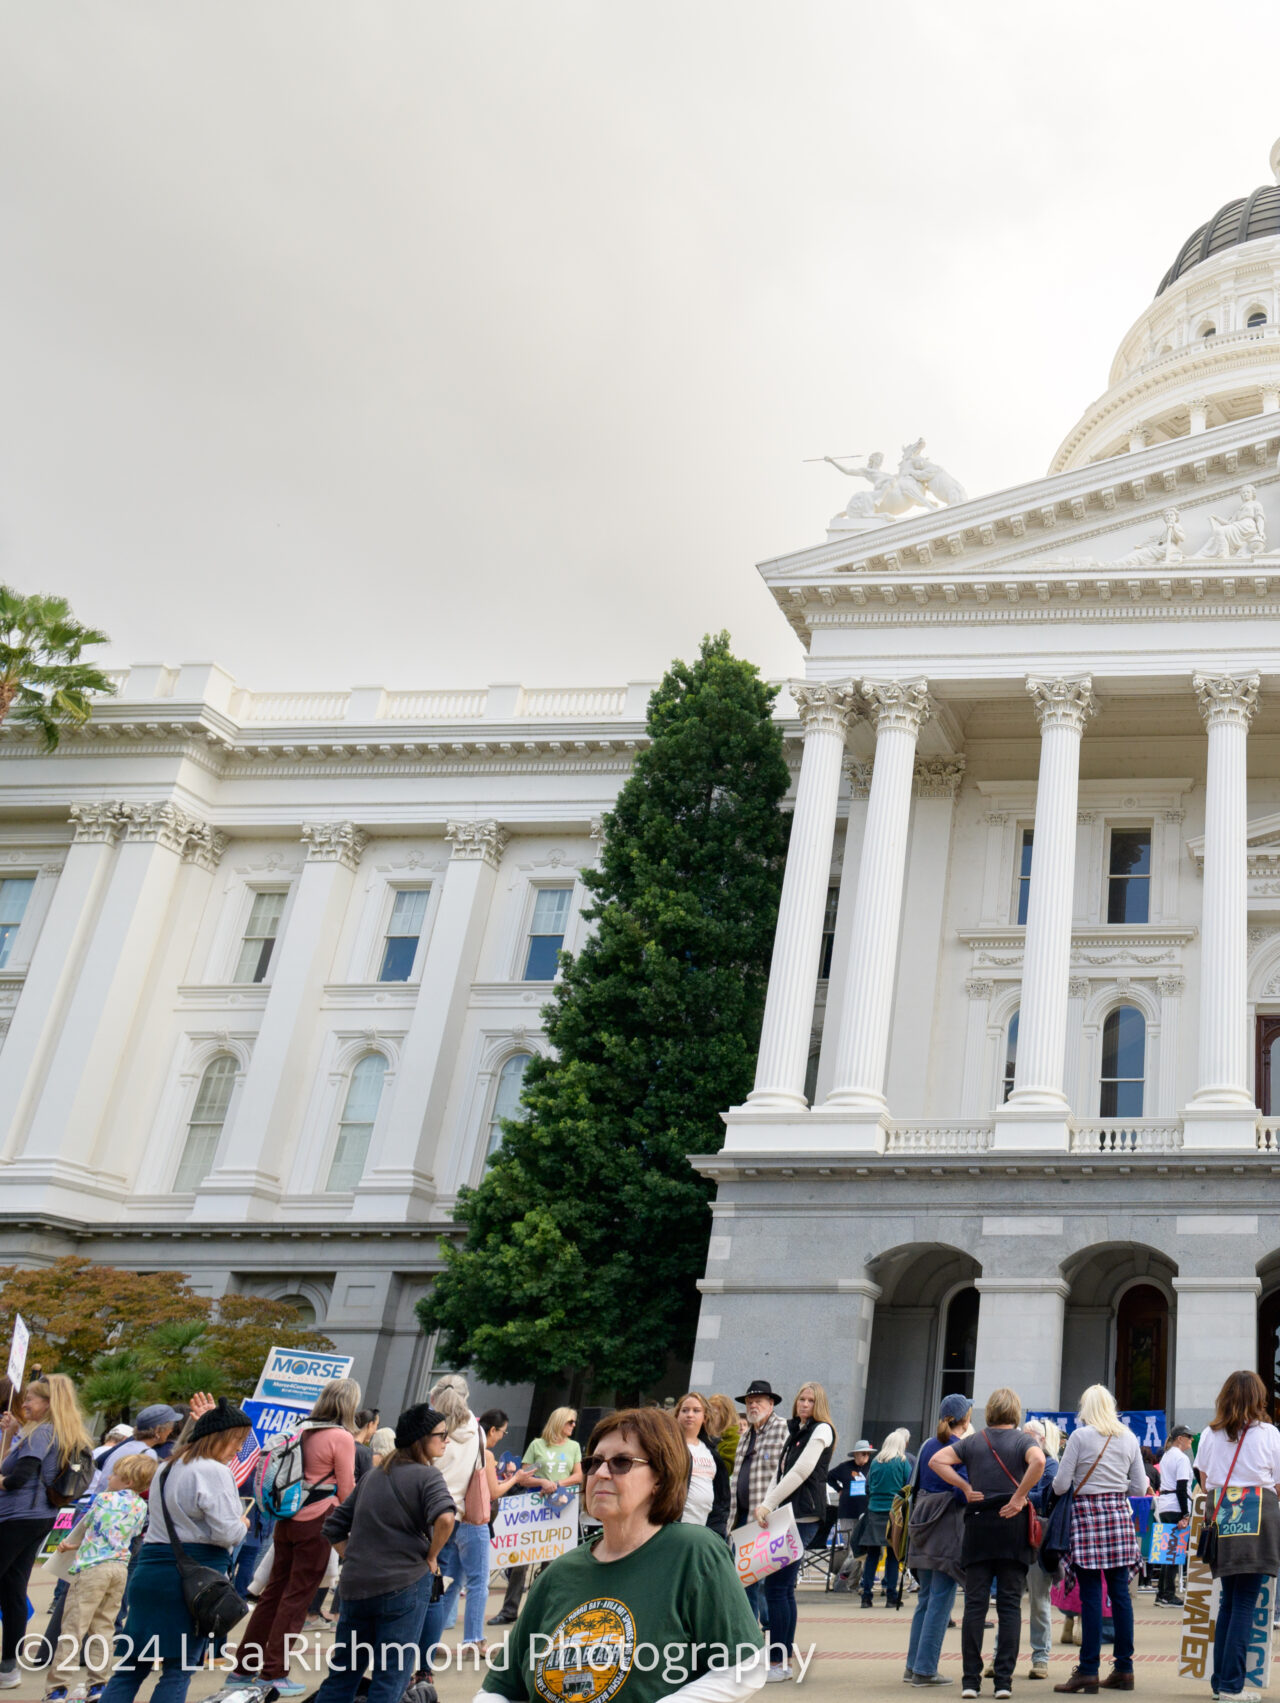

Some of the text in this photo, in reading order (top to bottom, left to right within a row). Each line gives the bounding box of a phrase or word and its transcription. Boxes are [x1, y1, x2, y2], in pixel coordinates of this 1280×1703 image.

[272, 1357, 344, 1379] MORSE
[504, 1508, 561, 1527] WOMEN
[1222, 1522, 1251, 1535] 2024
[520, 1526, 572, 1546] STUPID
[1150, 1524, 1164, 1562] BACK
[1160, 1532, 1170, 1550] GO
[1176, 1530, 1190, 1554] WE
[496, 1543, 565, 1567] CONMEN
[589, 1601, 601, 1610] BAY
[1179, 1590, 1216, 1679] WATER
[608, 1672, 625, 1694] PISMO
